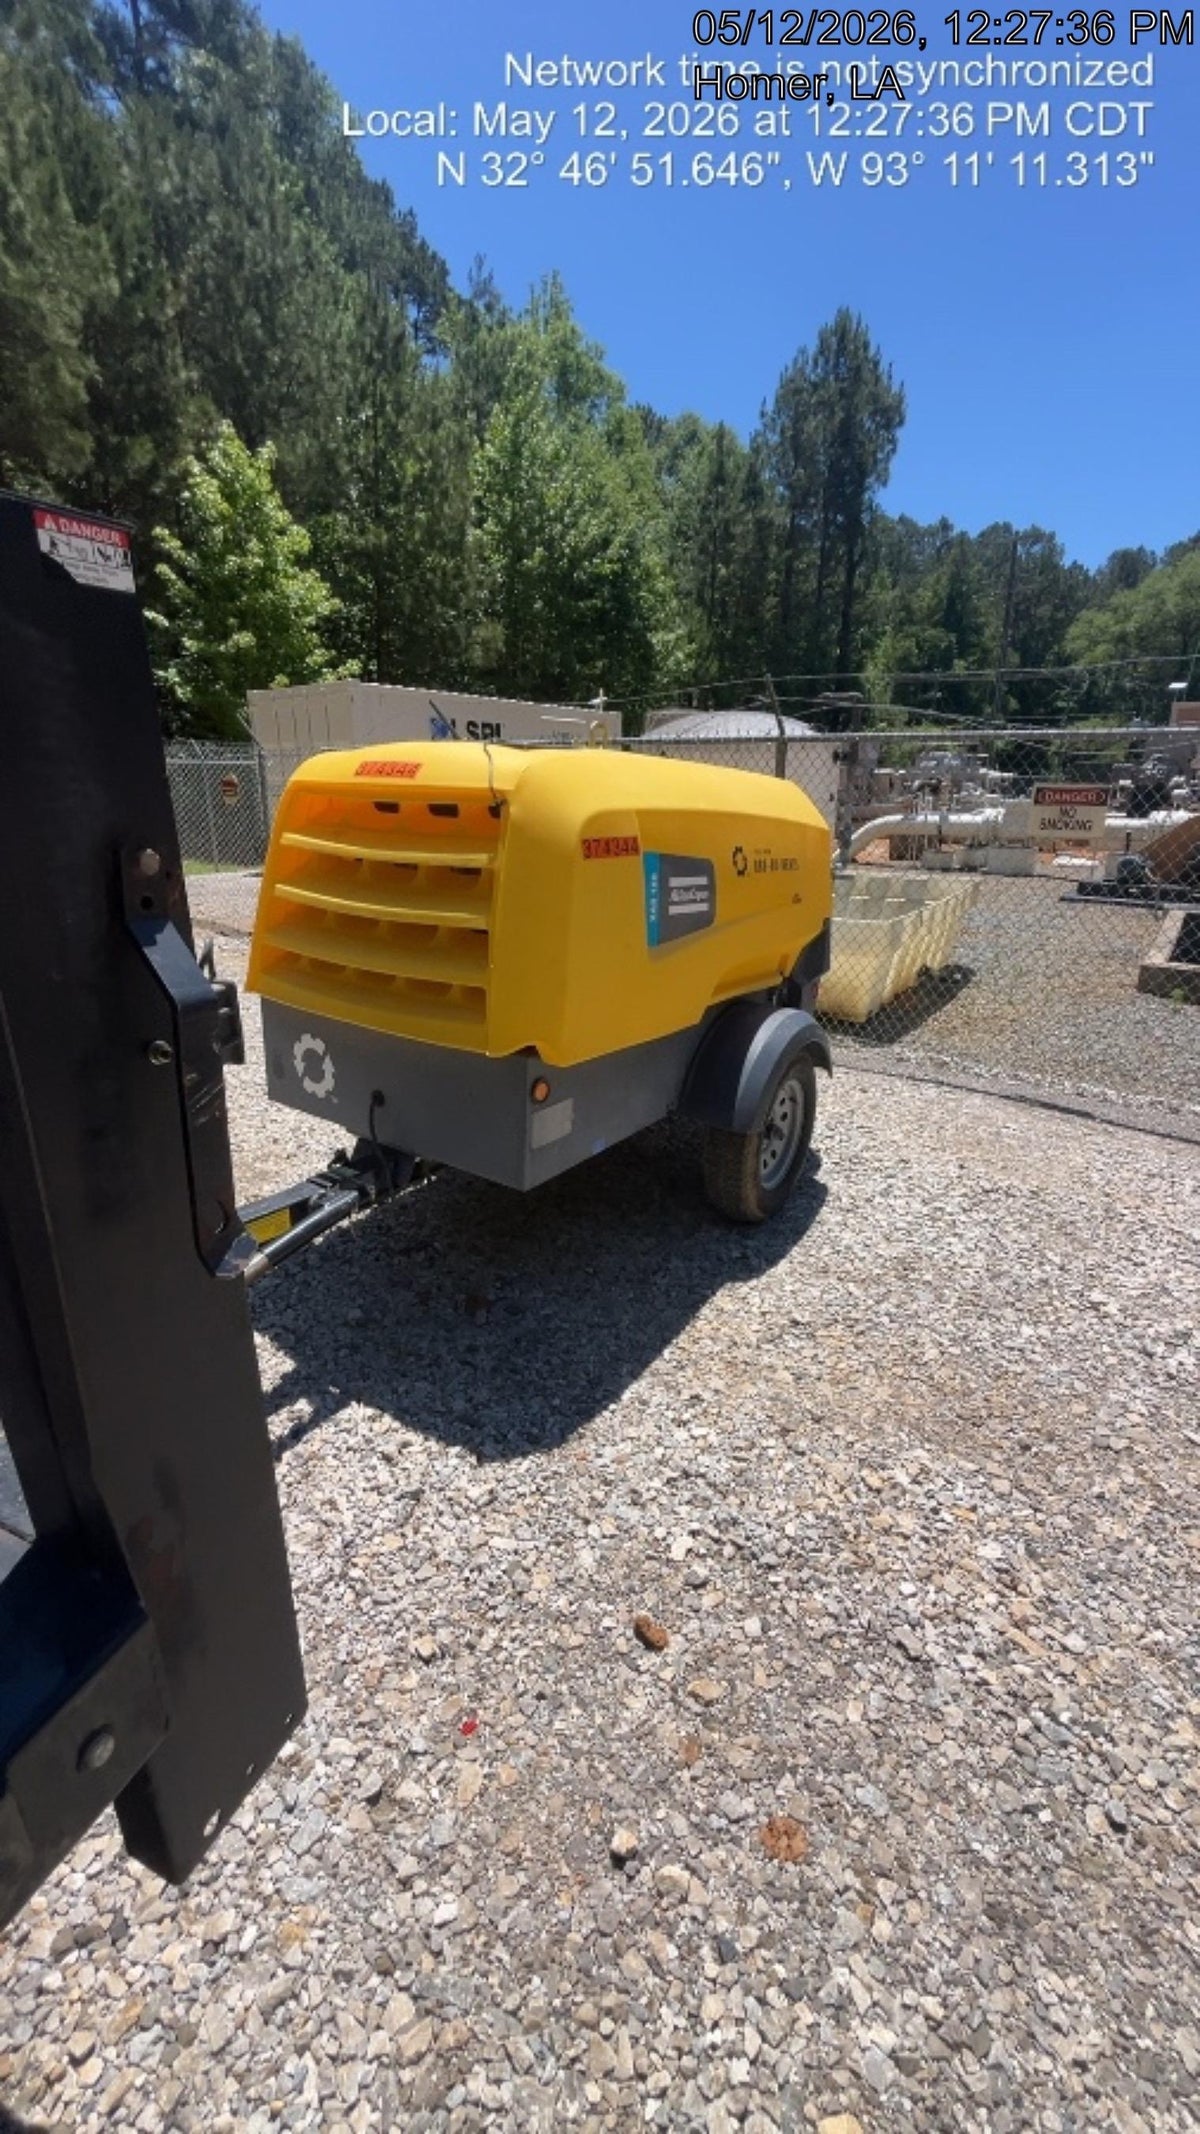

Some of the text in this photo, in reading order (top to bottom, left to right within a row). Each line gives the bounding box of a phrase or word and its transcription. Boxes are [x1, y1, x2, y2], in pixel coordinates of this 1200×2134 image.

[58, 517, 122, 548] DANGER
[1045, 791, 1097, 803] DANGER
[1060, 806, 1077, 818] NO
[1040, 818, 1093, 831] SMOKING
[582, 837, 639, 858] 374344
